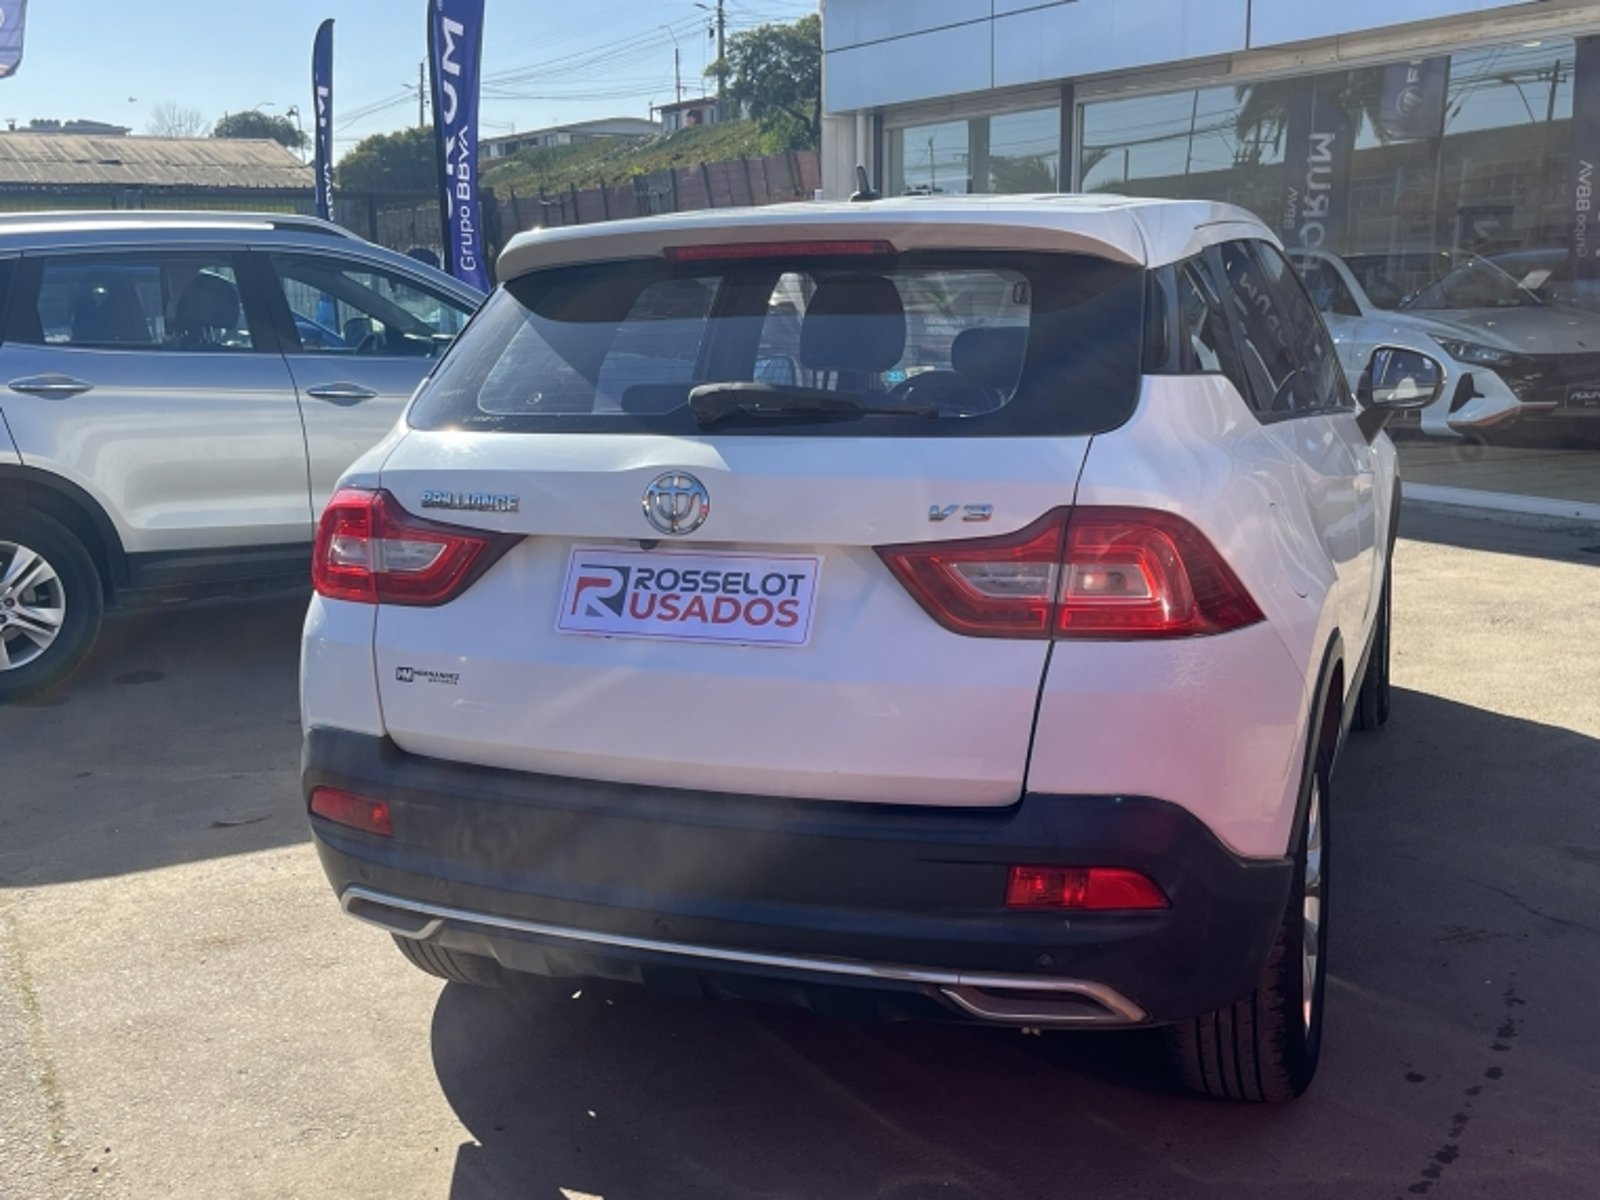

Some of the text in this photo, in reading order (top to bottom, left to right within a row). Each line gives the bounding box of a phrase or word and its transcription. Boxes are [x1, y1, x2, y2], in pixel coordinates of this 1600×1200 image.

[456, 125, 477, 271] Grupo BBVA
[928, 504, 994, 523] V3
[633, 567, 806, 597] ROSSELOT
[628, 592, 800, 628] USADOS
